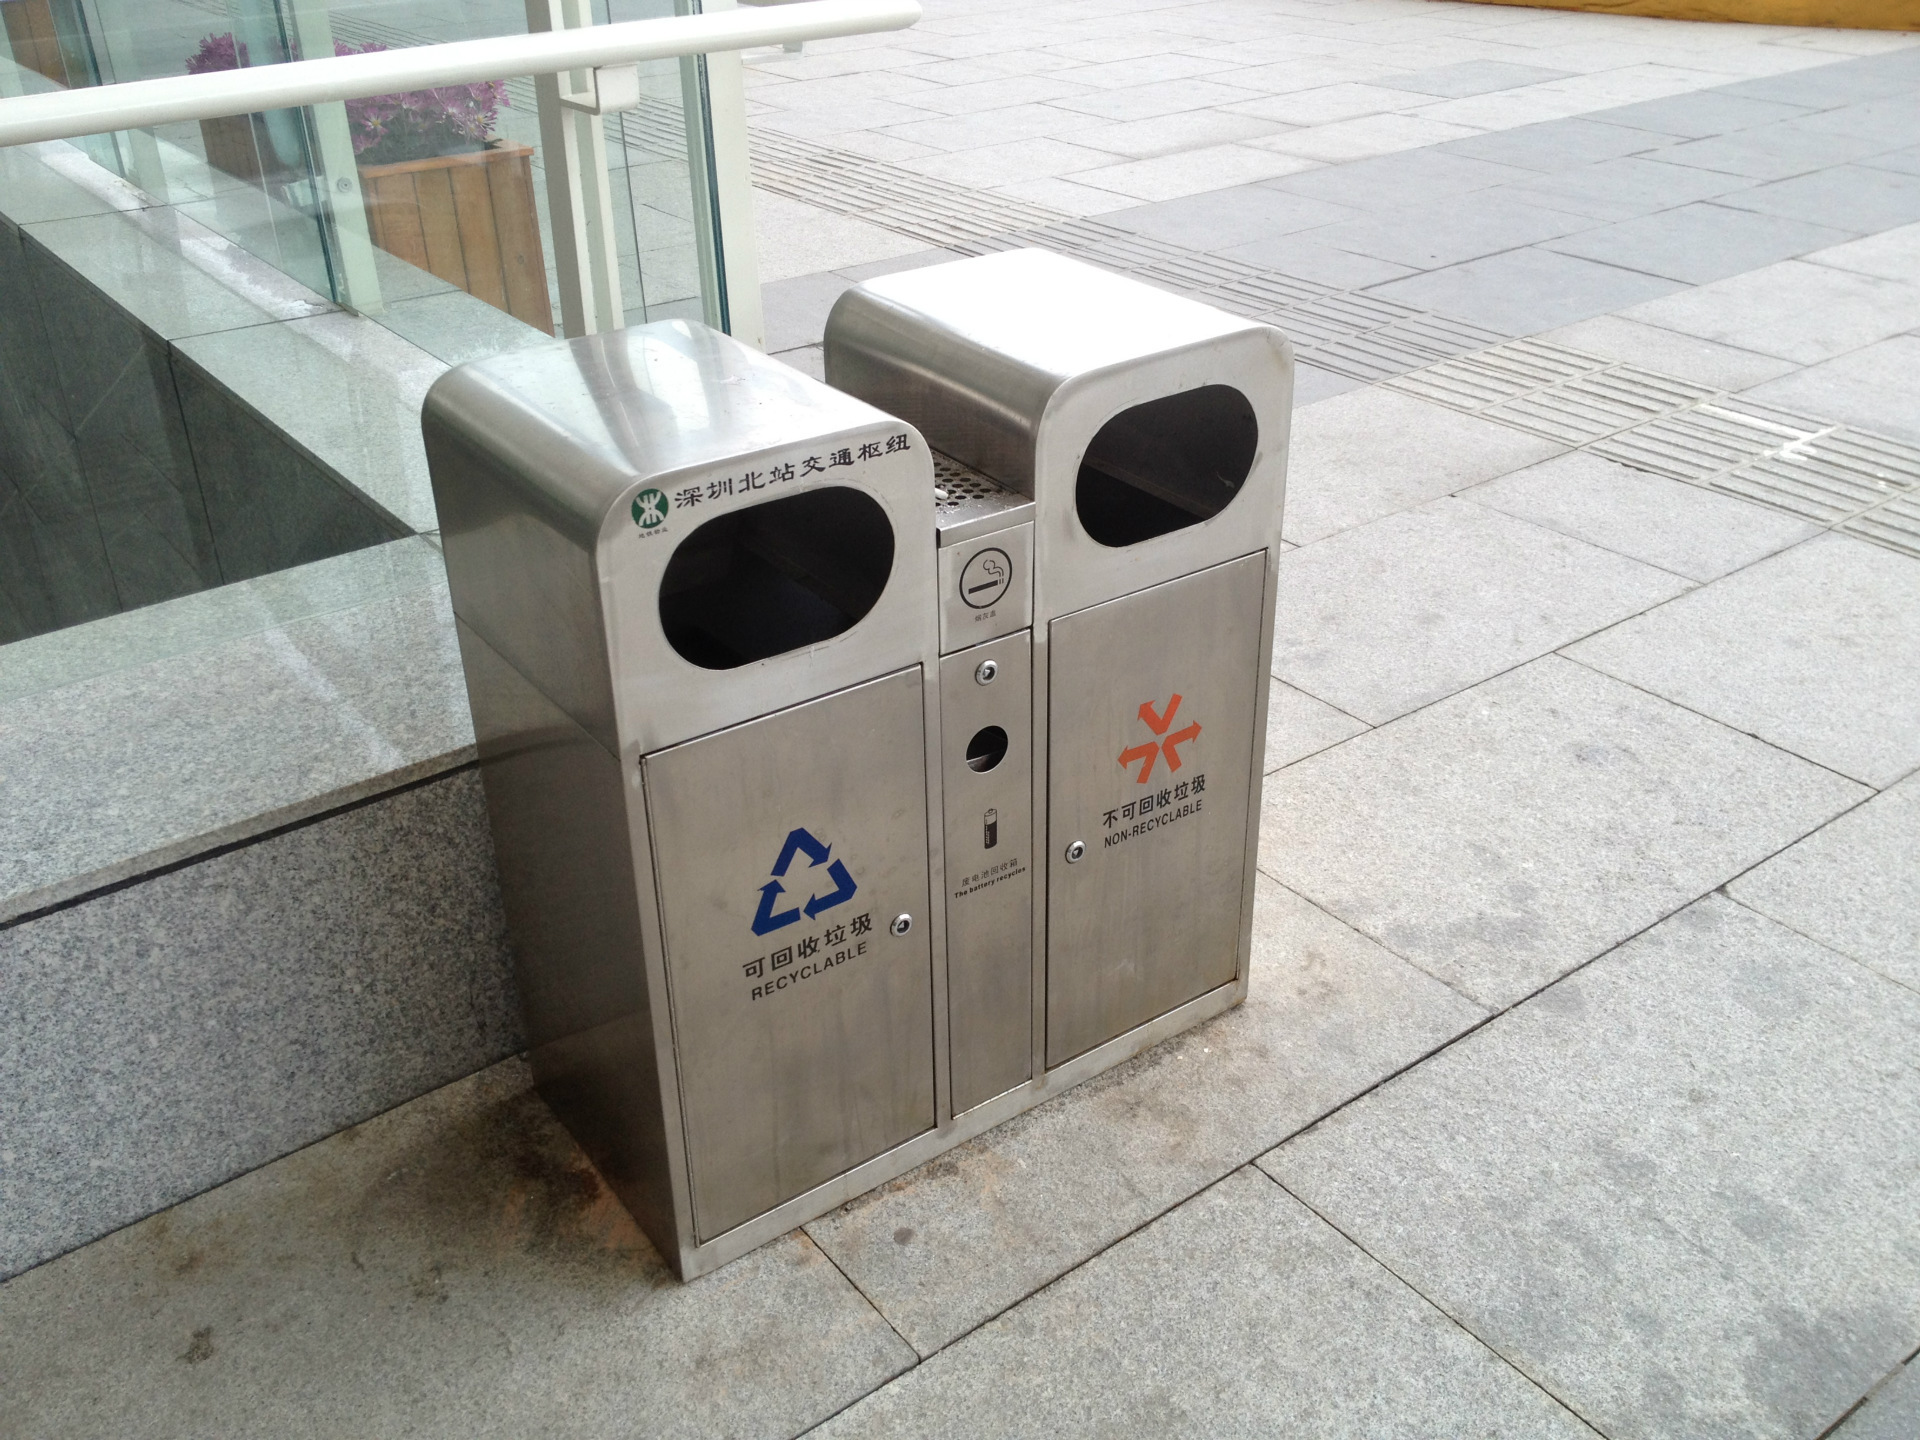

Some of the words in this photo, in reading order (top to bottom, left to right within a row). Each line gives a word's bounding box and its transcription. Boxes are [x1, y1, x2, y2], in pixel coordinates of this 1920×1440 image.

[674, 434, 911, 509] 深圳北站交通枢纽
[1102, 774, 1206, 829] 不可回收垃圾
[1104, 799, 1203, 848] NON-RECYCLABLE
[954, 890, 968, 898] The
[969, 879, 995, 893] battery
[742, 912, 872, 978] 可回收垃圾
[751, 941, 867, 1001] RECYCLABLE
